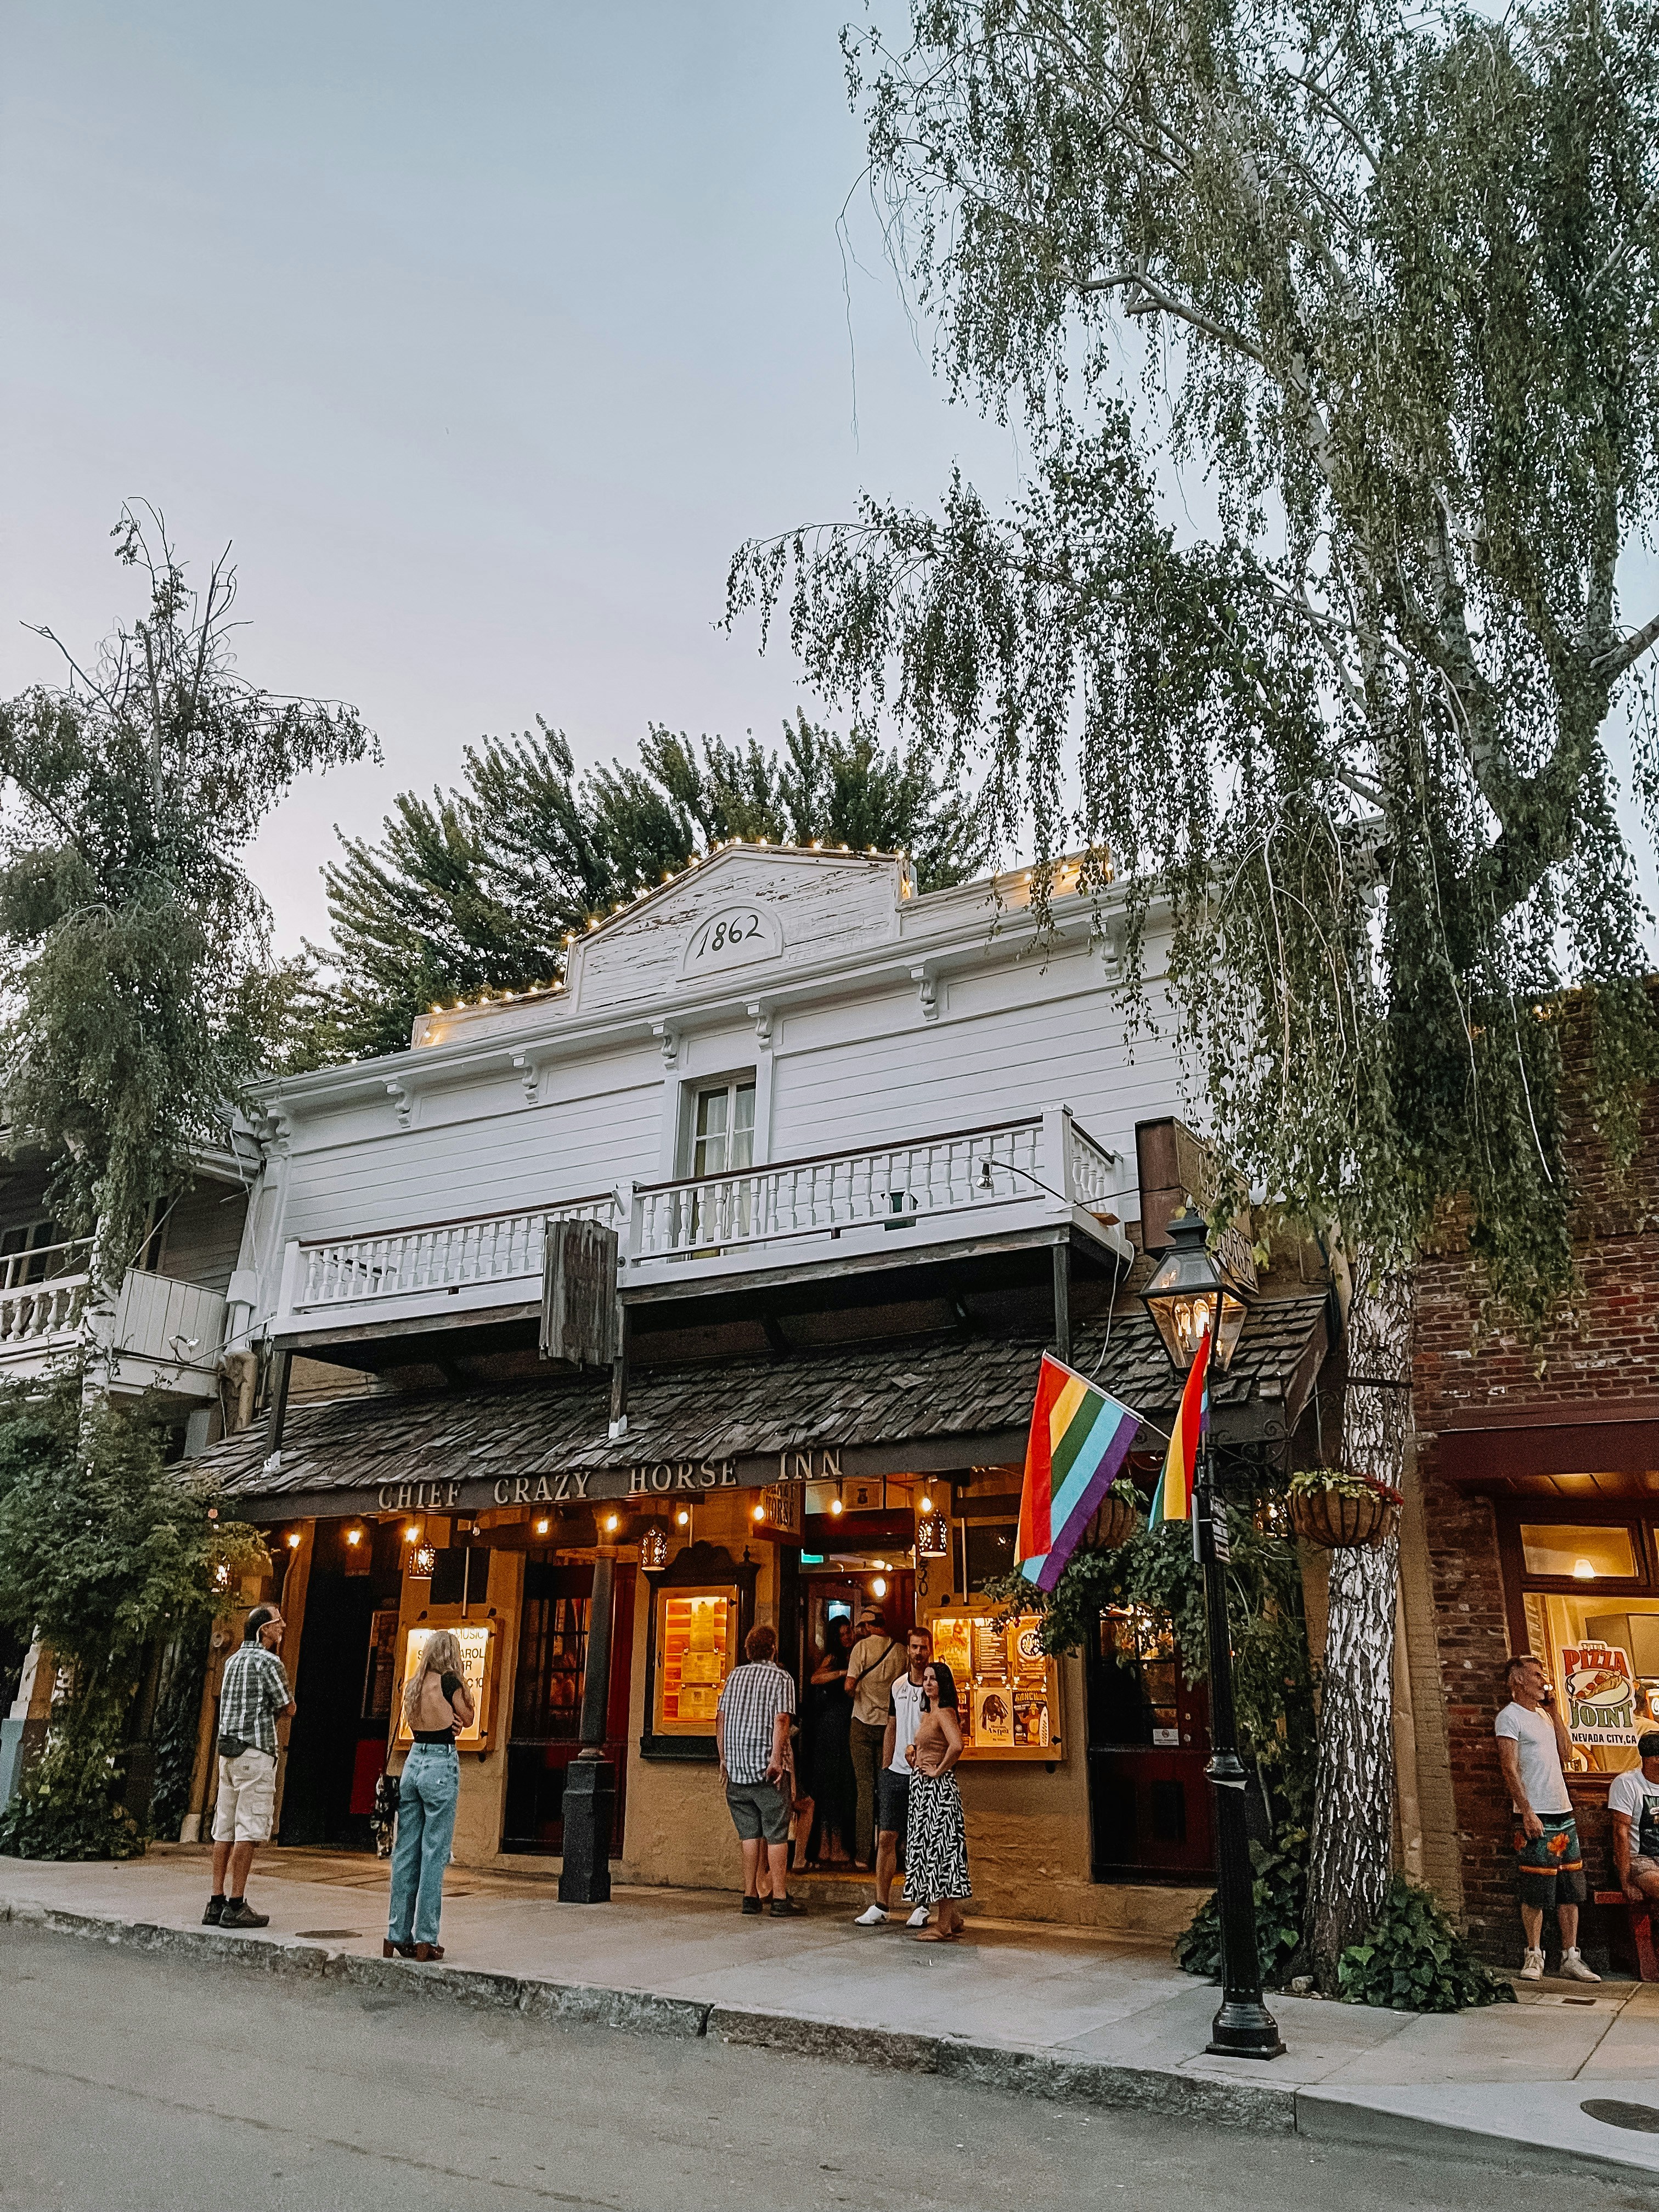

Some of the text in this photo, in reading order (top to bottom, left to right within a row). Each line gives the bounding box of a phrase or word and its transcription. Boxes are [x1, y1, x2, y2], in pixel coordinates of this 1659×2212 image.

[696, 915, 766, 960] 1862
[378, 1448, 843, 1510] CHIEF CRAZY HORSE INN
[1562, 1649, 1630, 1679] PIZZA
[1568, 1698, 1633, 1729] JOINT
[1571, 1733, 1605, 1743] NEVADA
